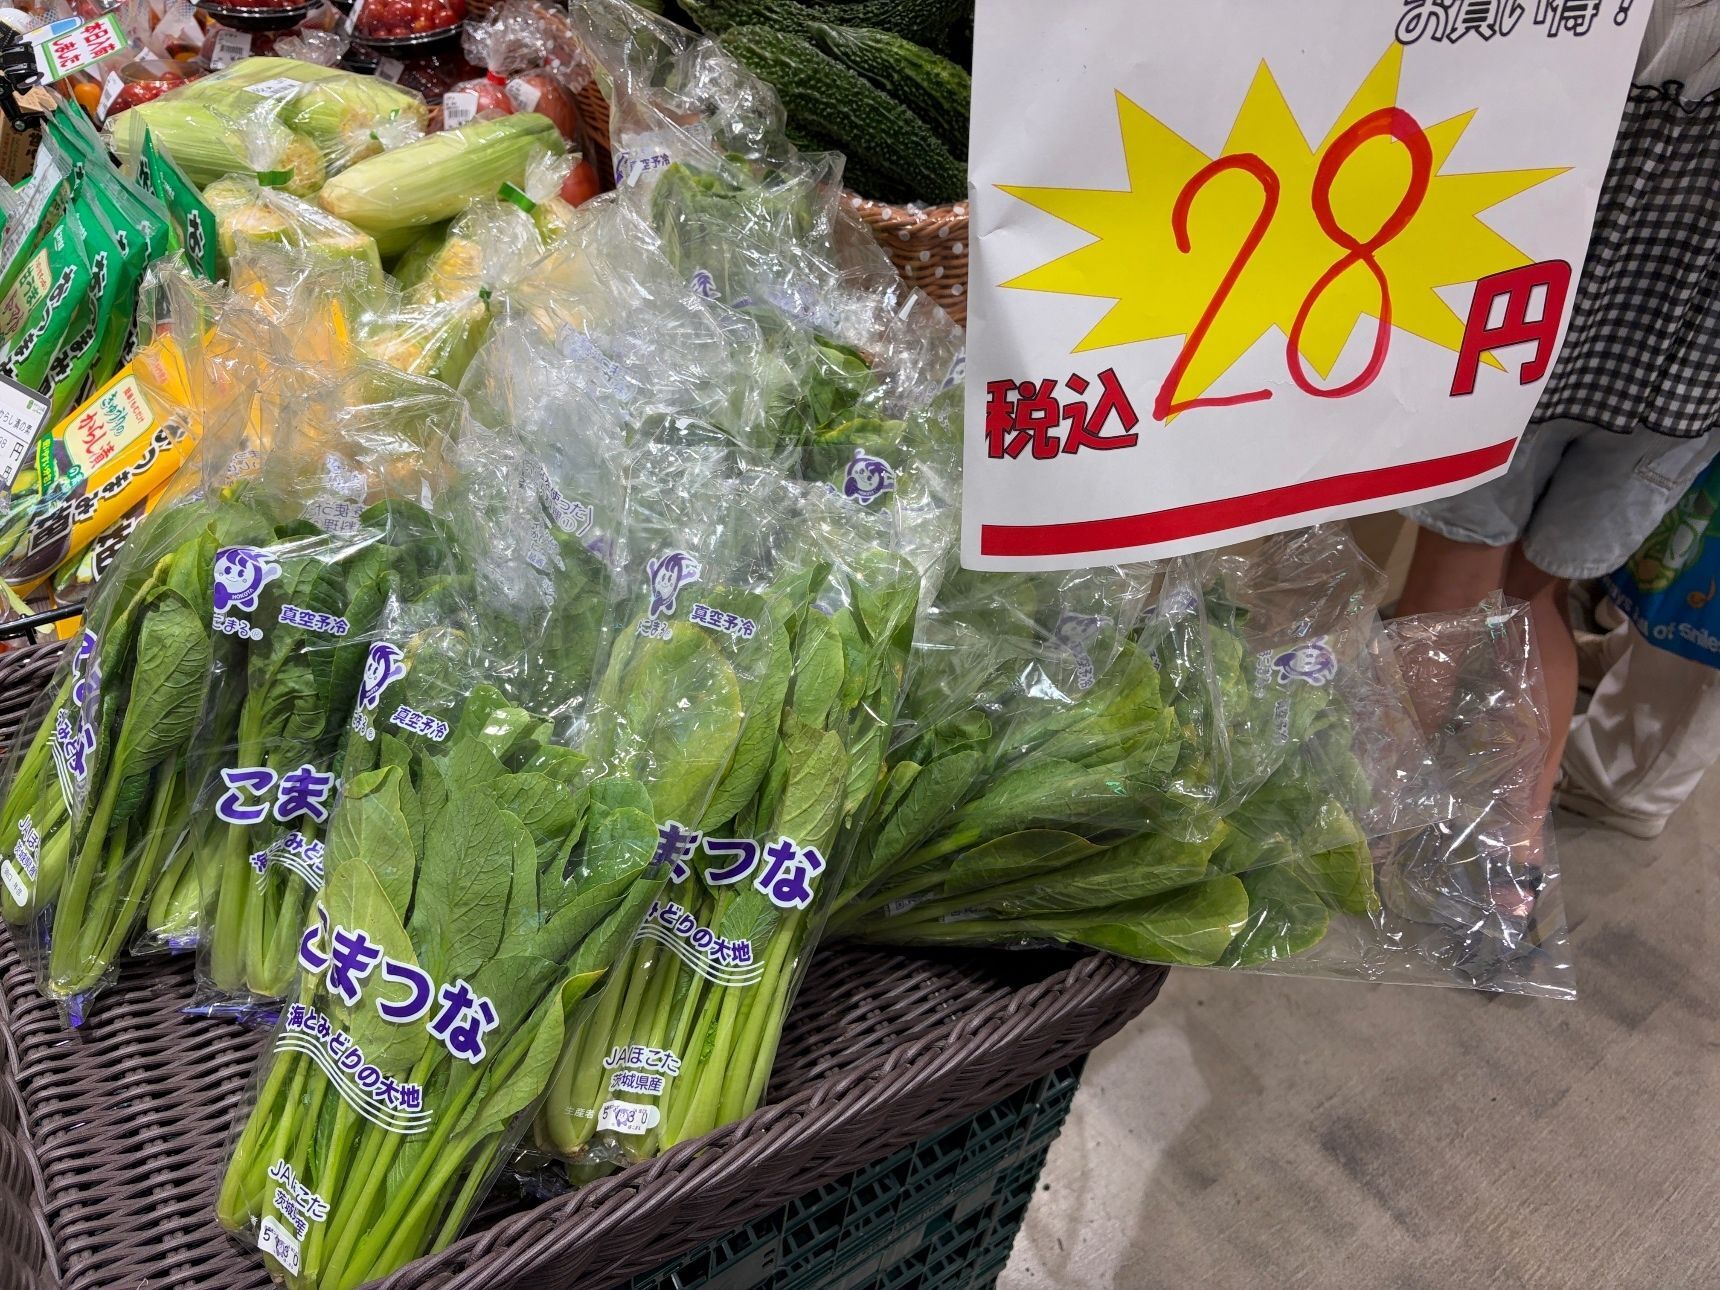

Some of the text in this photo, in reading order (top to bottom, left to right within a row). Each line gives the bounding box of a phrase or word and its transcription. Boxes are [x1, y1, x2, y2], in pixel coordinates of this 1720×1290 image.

[986, 106, 1574, 461] 税込 28 円
[78, 411, 116, 469] からし漬
[281, 606, 349, 635] 真空予冷
[691, 604, 755, 637] 真空予冷
[392, 706, 448, 740] 真空予冷
[287, 1005, 423, 1109] 海とみどりの大地
[605, 1046, 679, 1074] JAほこた
[610, 1071, 663, 1094] 茨城県産
